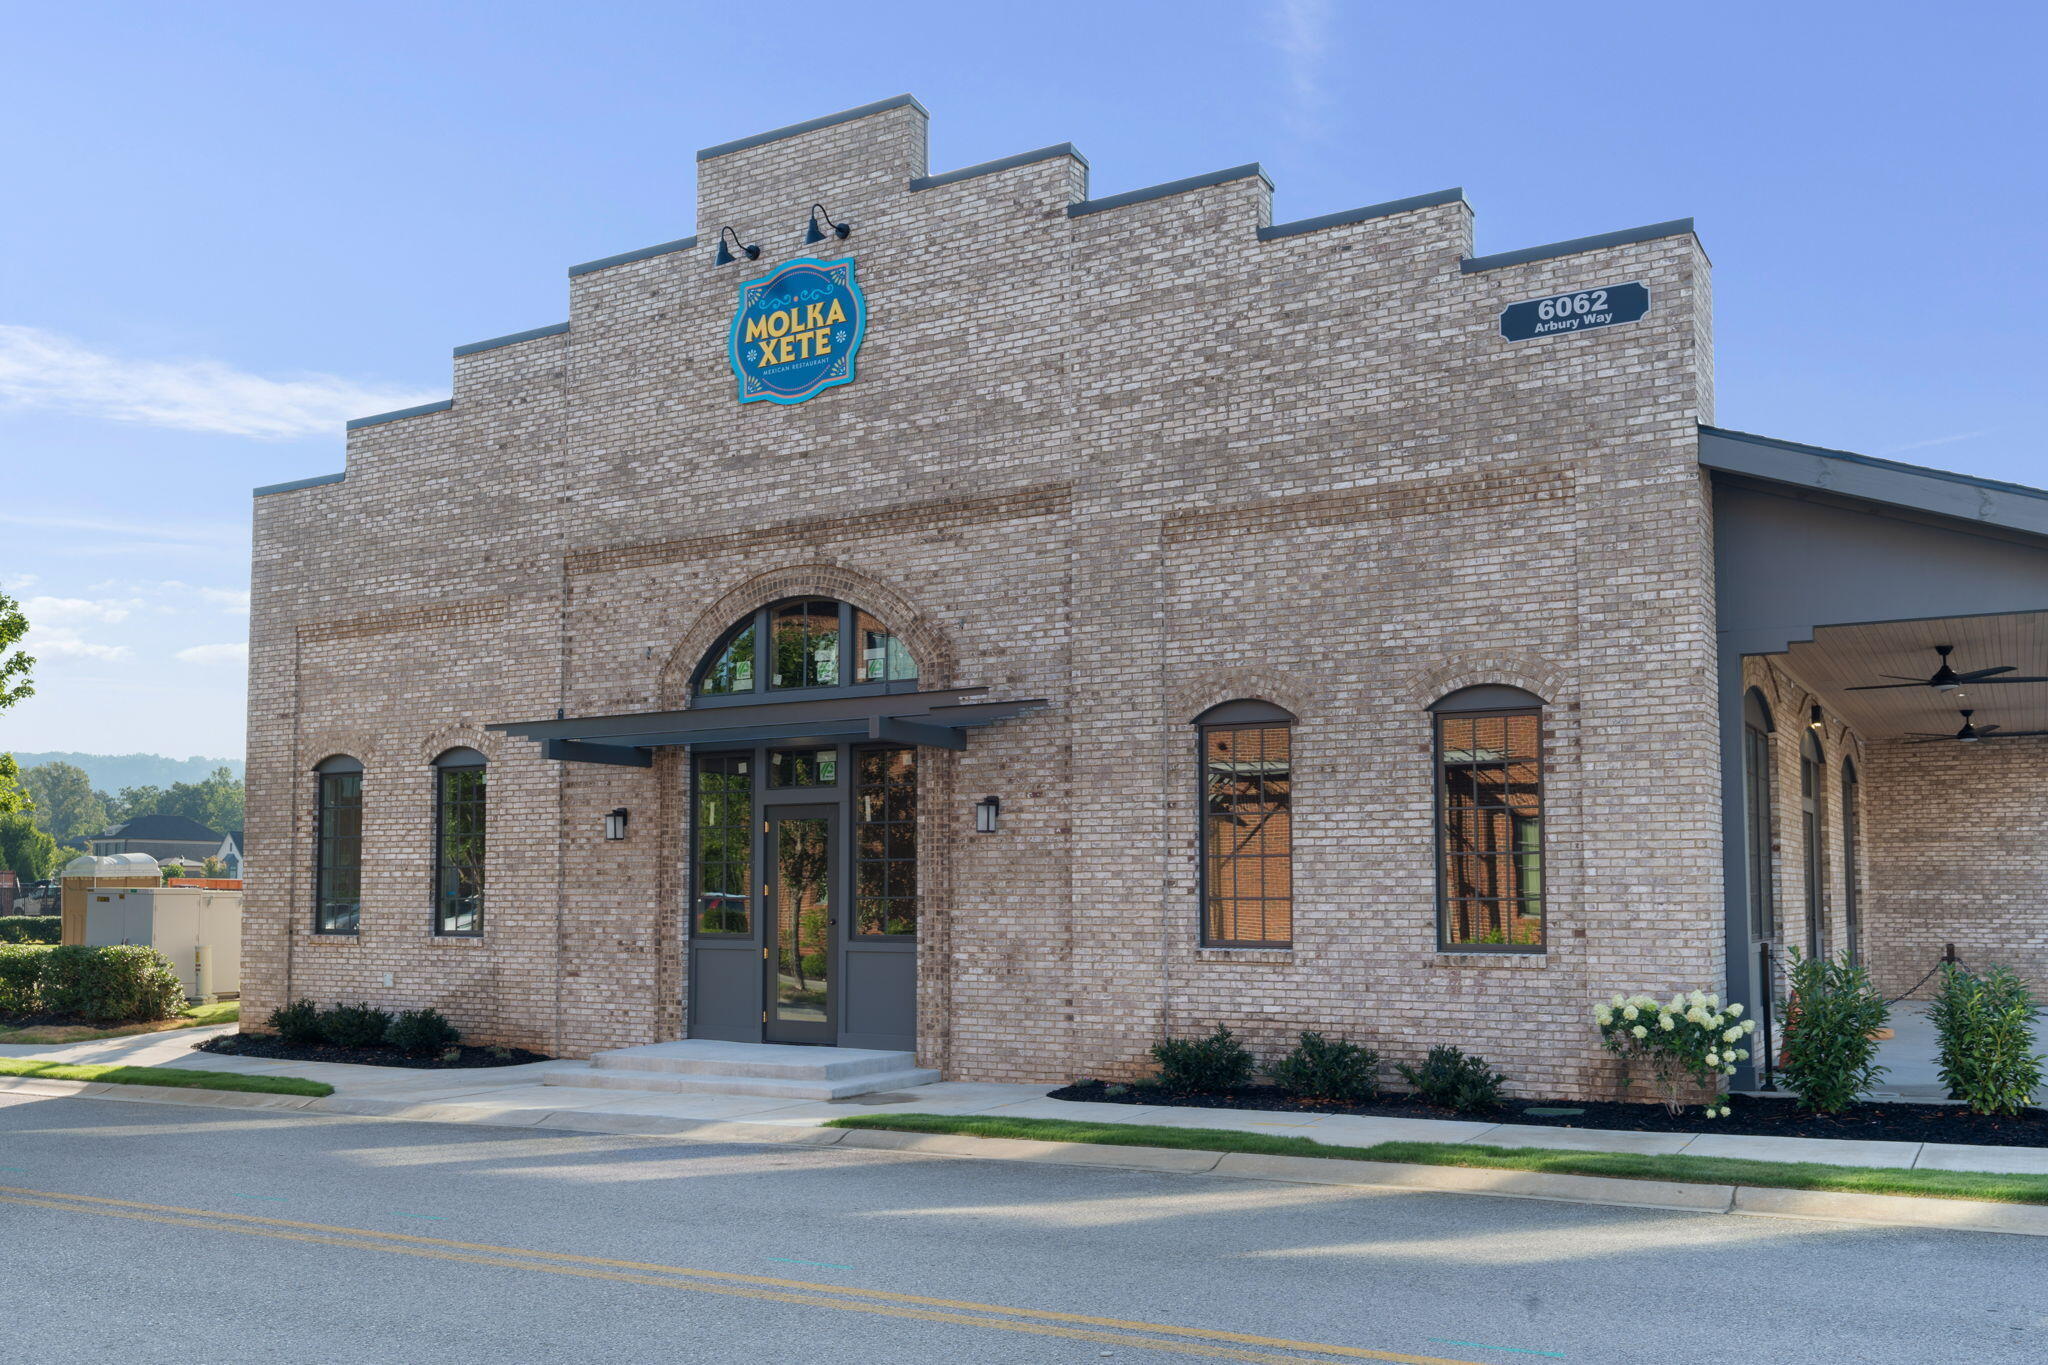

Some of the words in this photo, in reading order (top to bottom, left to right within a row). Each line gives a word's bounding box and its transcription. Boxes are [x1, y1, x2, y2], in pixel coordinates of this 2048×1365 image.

[1538, 290, 1608, 320] 6062
[745, 298, 847, 343] MOLKA
[1534, 318, 1579, 333] Arbury
[1583, 312, 1613, 325] Way
[758, 327, 832, 368] XETE
[763, 366, 790, 376] MEXICAN
[792, 357, 830, 370] RESTAURANT
